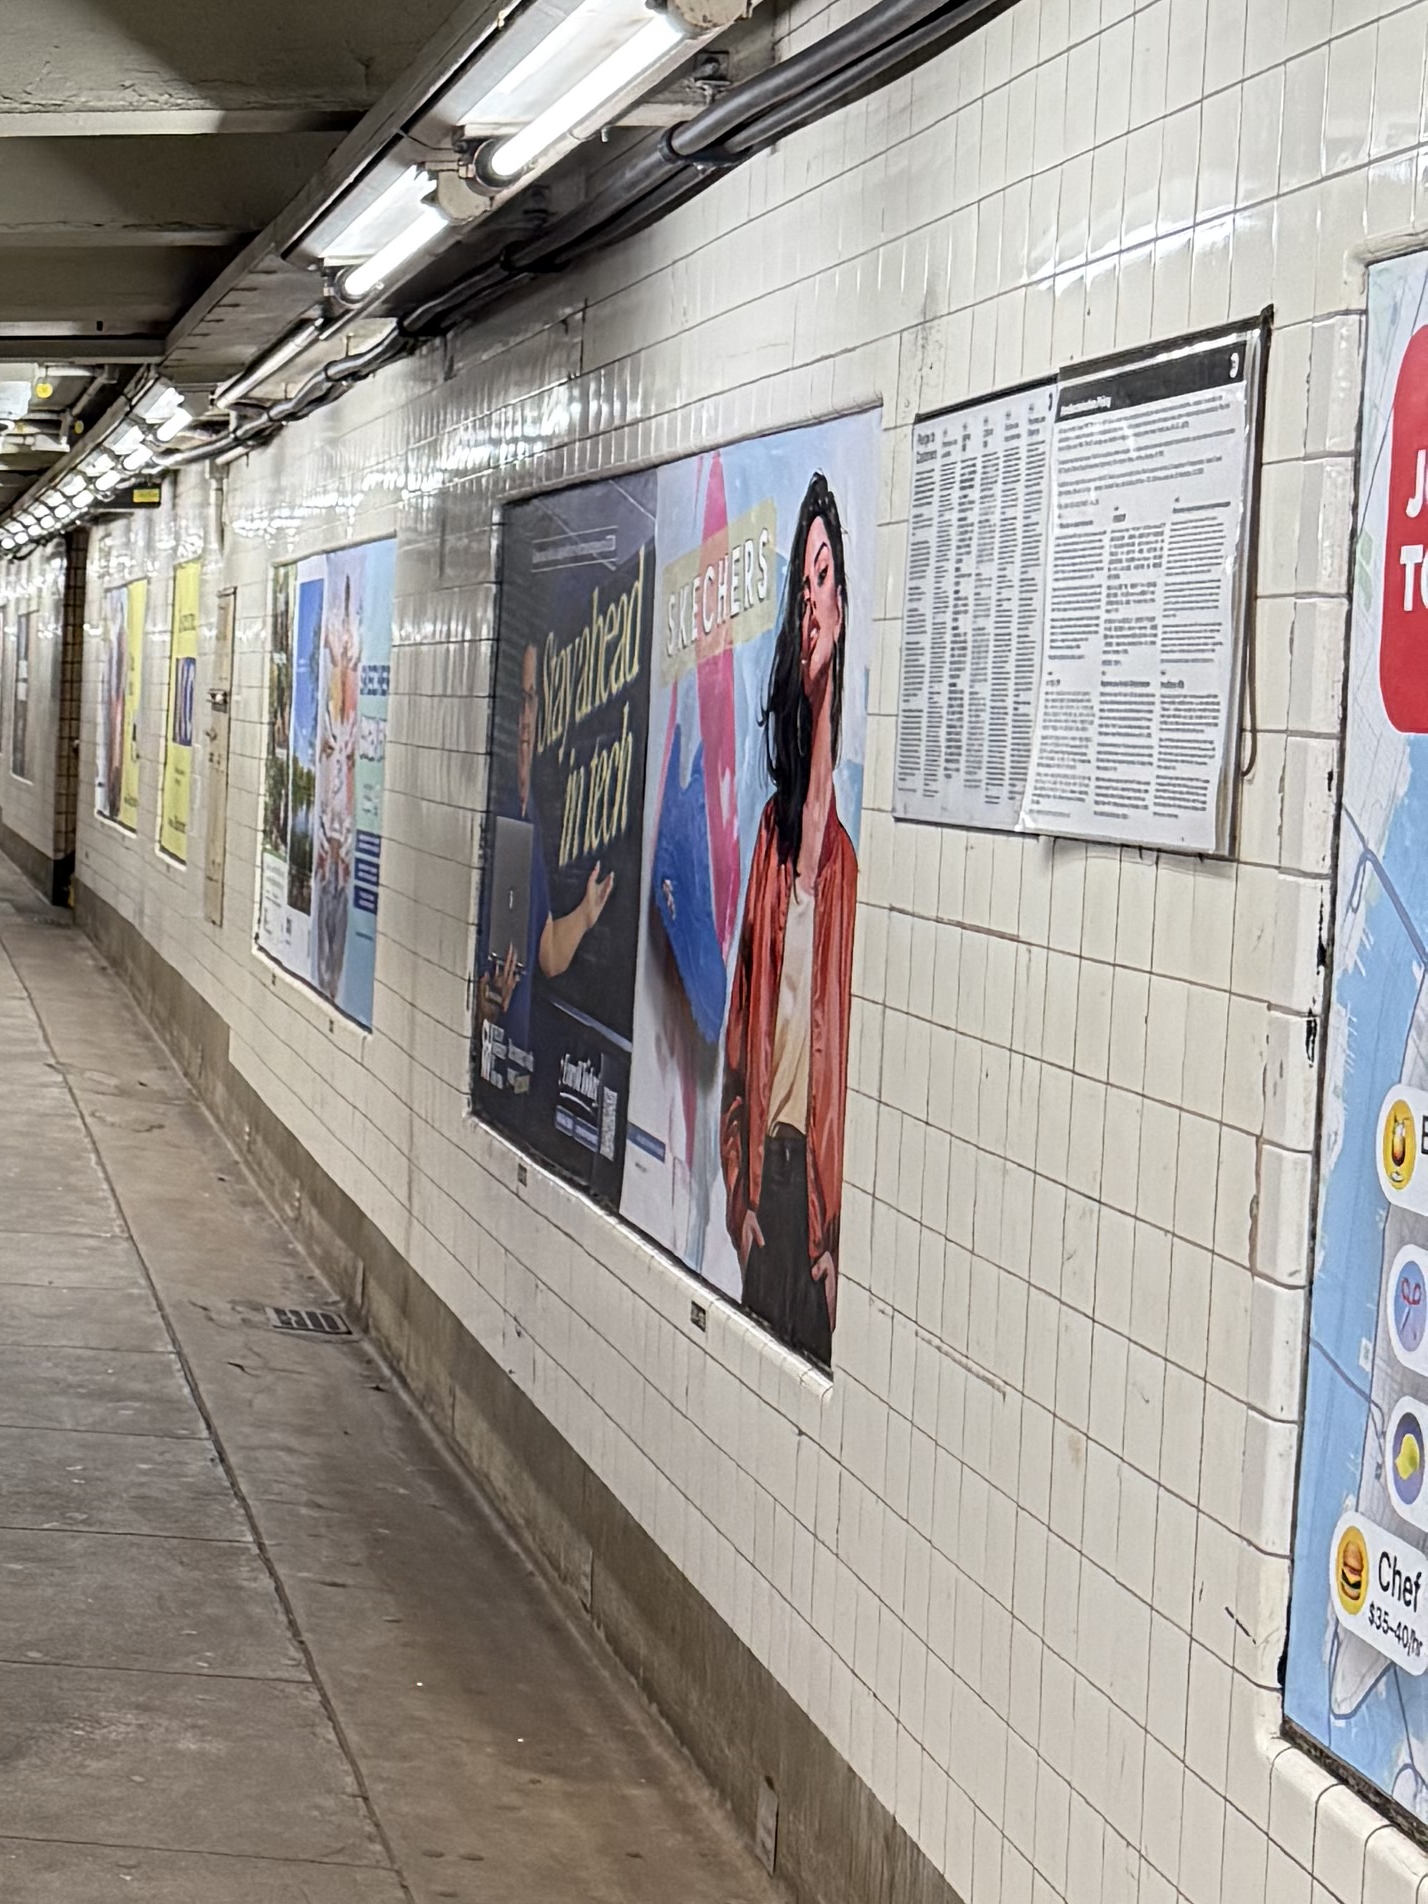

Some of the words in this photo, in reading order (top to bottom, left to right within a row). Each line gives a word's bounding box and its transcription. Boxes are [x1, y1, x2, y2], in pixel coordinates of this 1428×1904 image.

[537, 631, 580, 765] Stay
[575, 543, 645, 723] ahead
[666, 527, 770, 658] SKECHERS
[558, 747, 585, 868] in
[583, 700, 633, 857] tech
[1378, 1550, 1423, 1613] Chef
